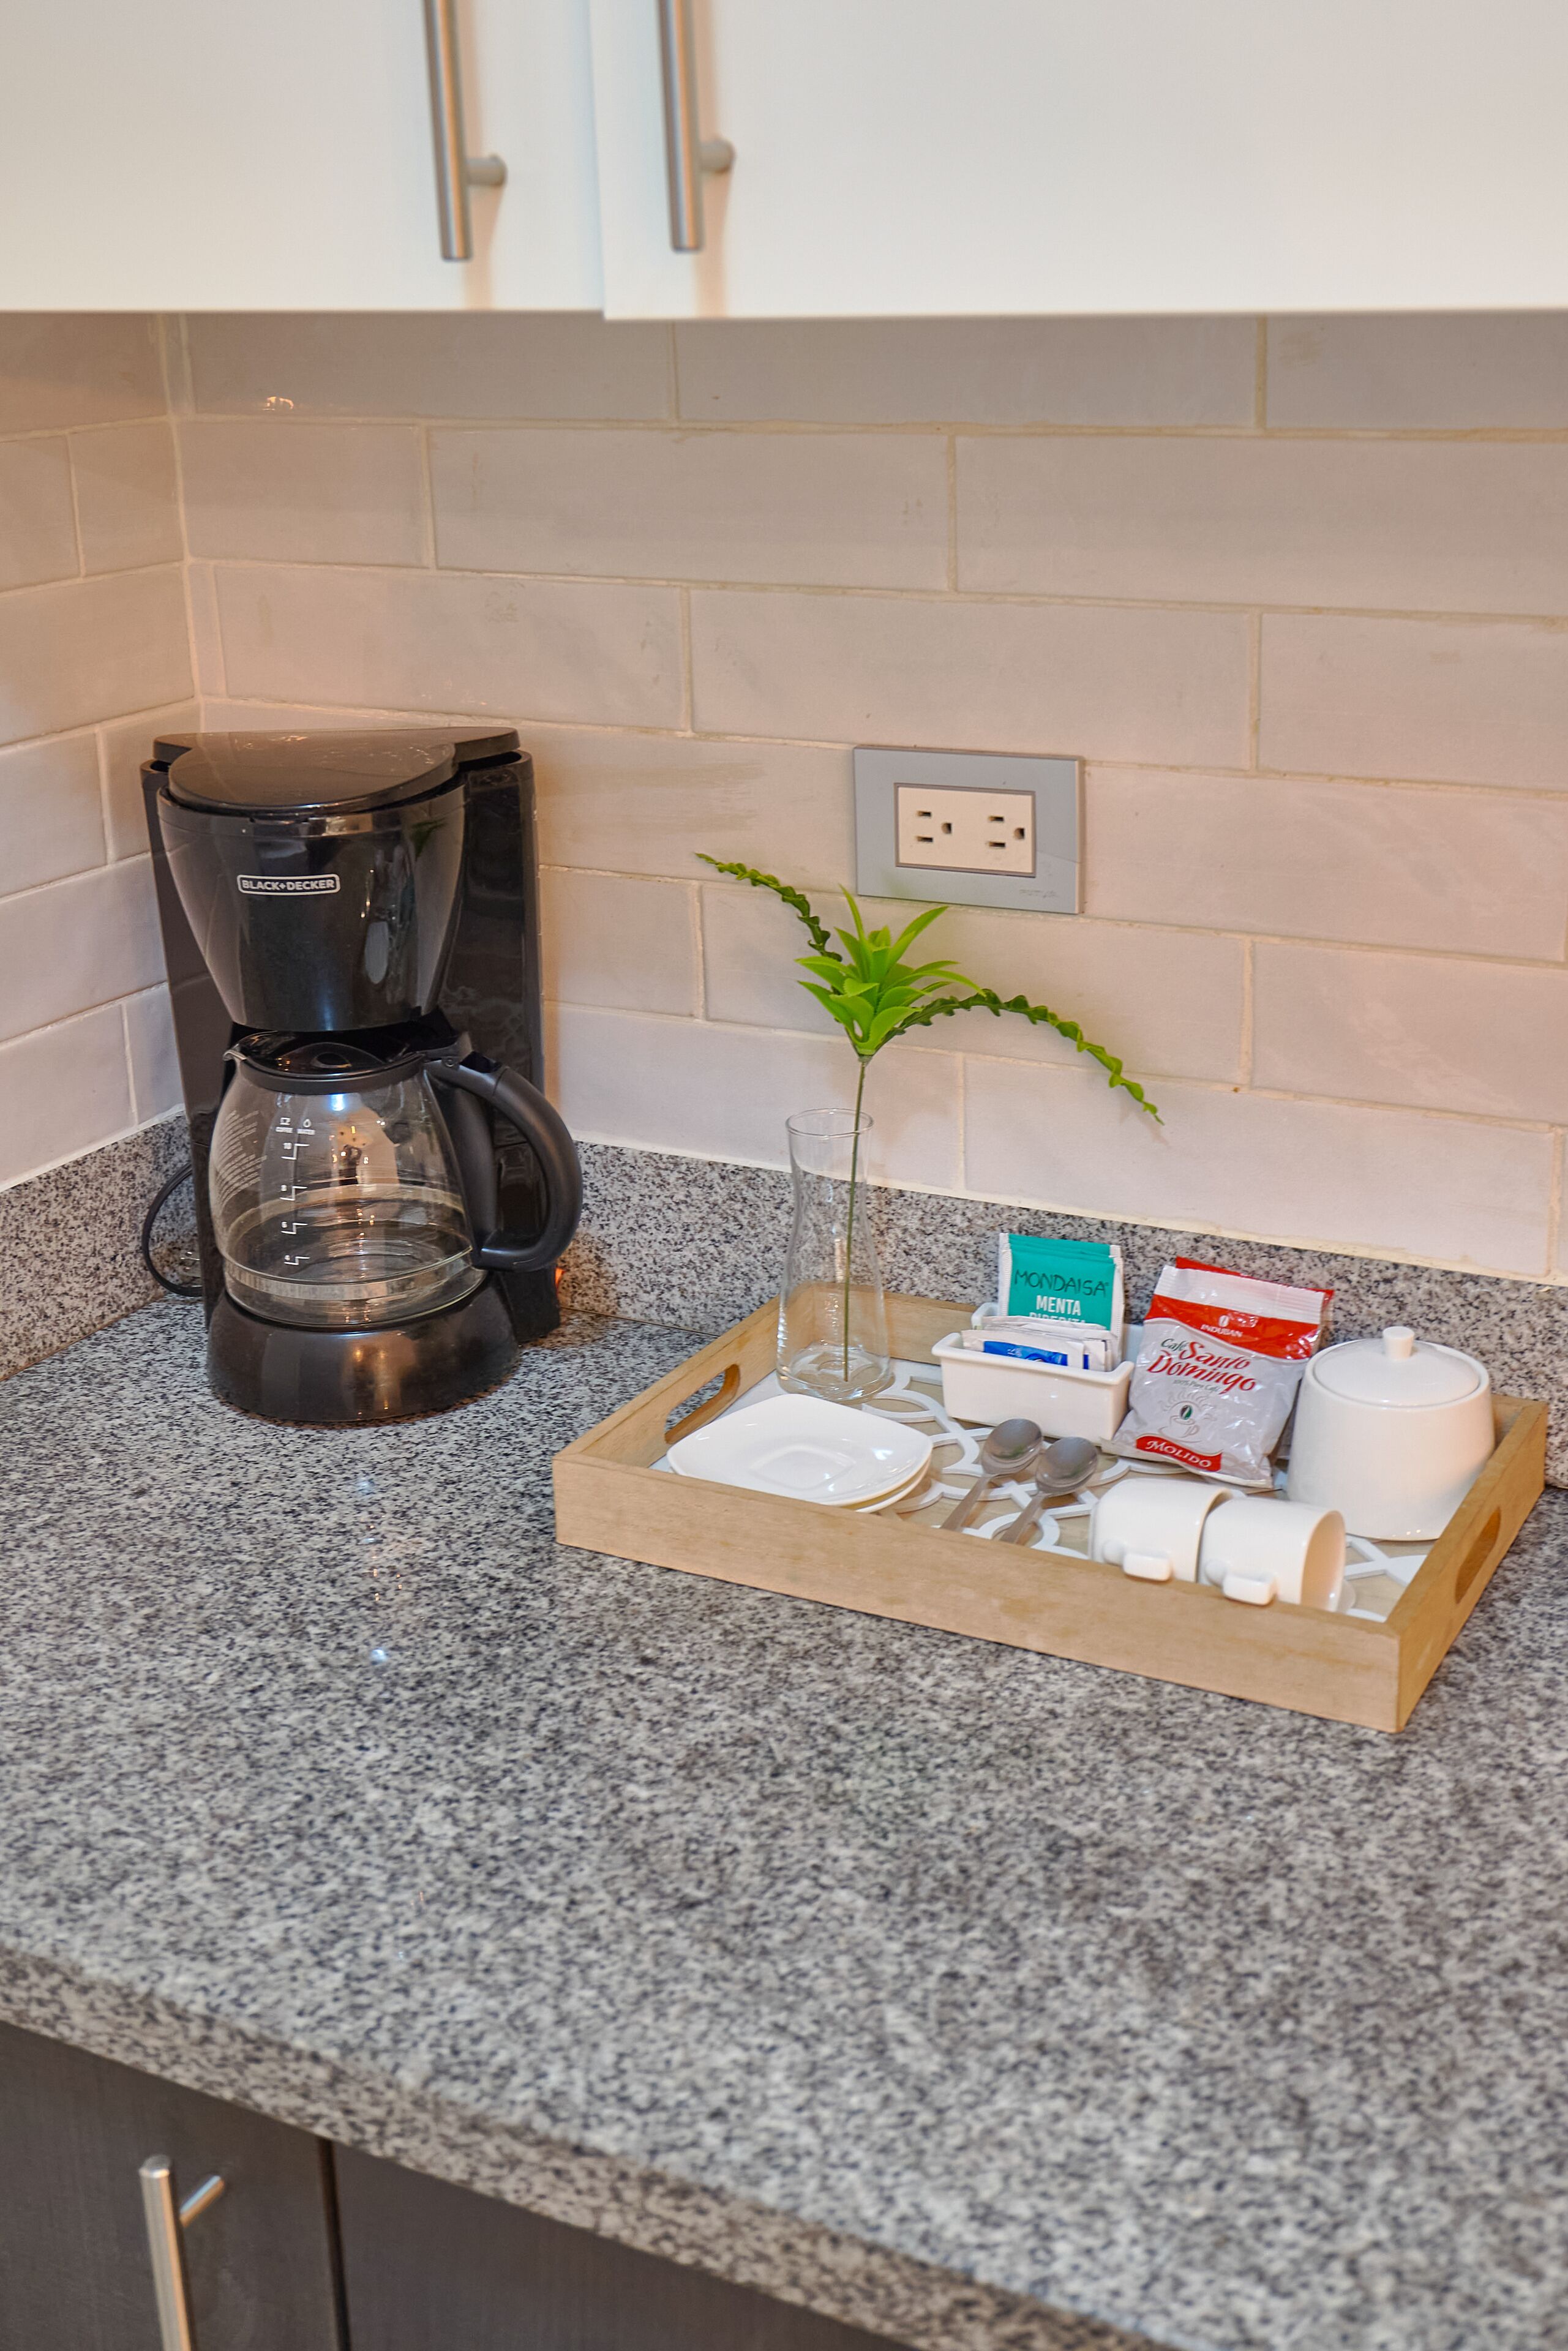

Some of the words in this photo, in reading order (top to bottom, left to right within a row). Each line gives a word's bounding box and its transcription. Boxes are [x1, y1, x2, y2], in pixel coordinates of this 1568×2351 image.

[241, 879, 335, 891] BLACK+DECKER
[1014, 1269, 1106, 1297] MONDAISA
[1036, 1295, 1081, 1316] MENTA
[1201, 1324, 1243, 1338] INDUBAN
[1179, 1341, 1251, 1370] Santo
[1147, 1349, 1256, 1395] Domingo
[1145, 1441, 1212, 1468] MOLIDO
